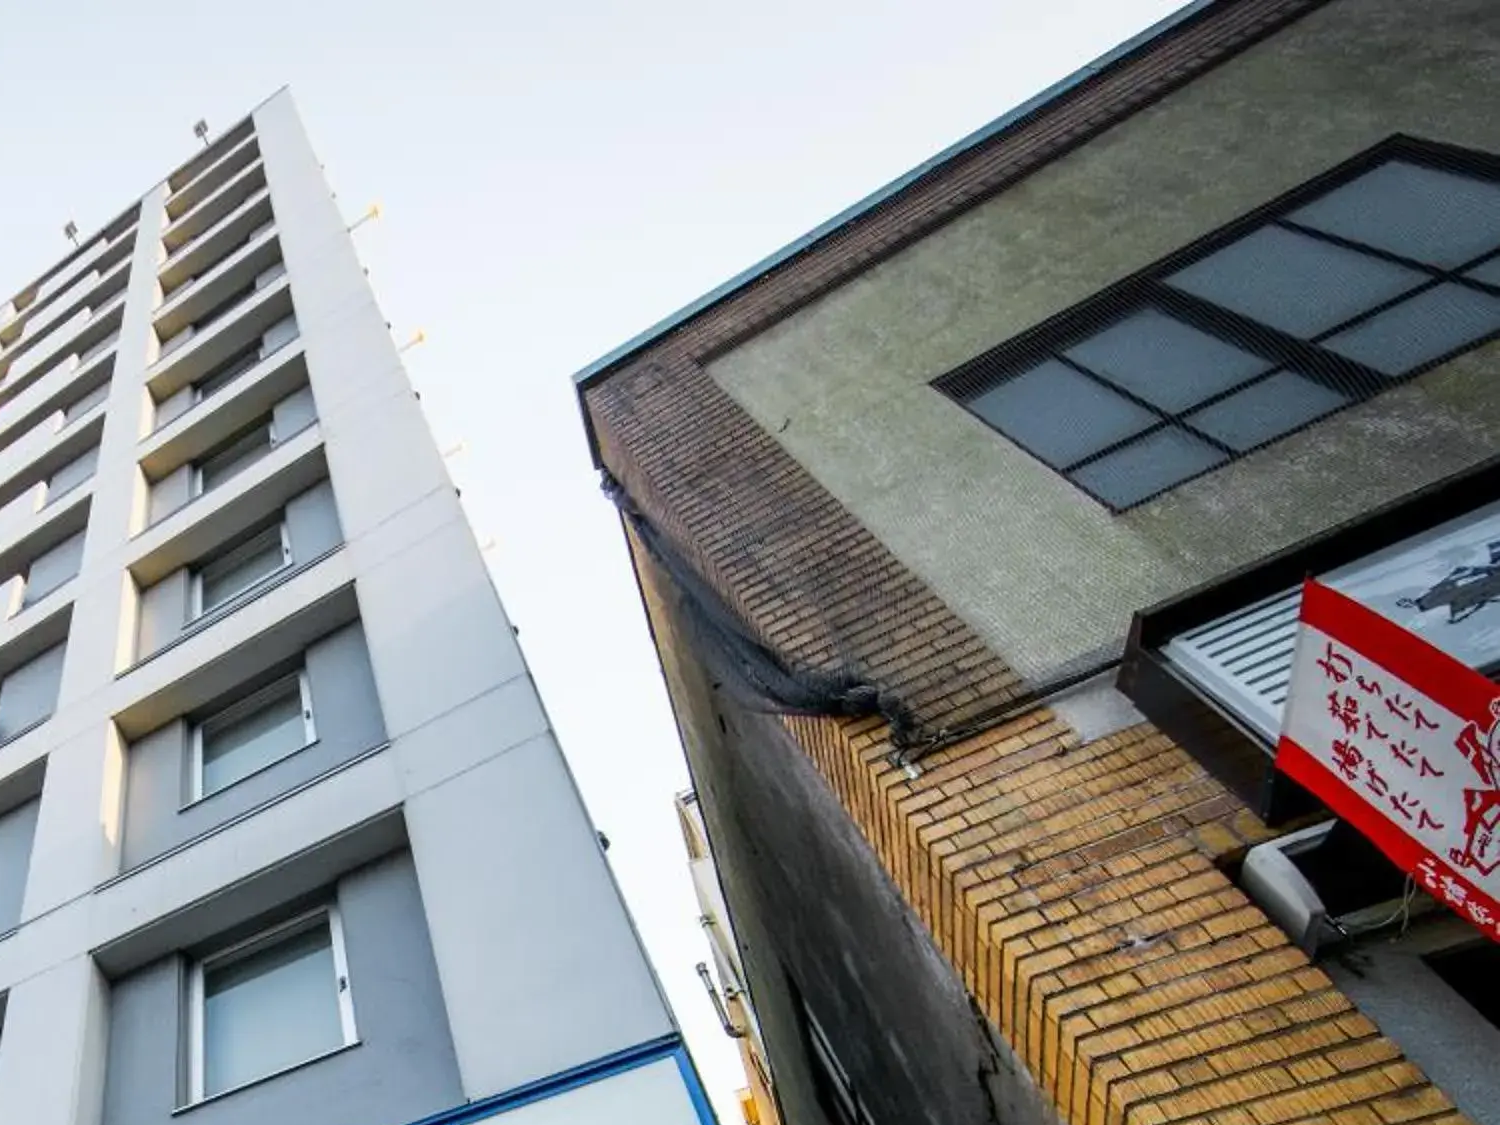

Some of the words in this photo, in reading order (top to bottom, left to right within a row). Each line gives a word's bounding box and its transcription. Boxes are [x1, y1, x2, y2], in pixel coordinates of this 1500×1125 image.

[1315, 641, 1440, 730] 打ちたて
[1327, 690, 1445, 778] 茹でたて
[1331, 739, 1445, 829] 揚げたて
